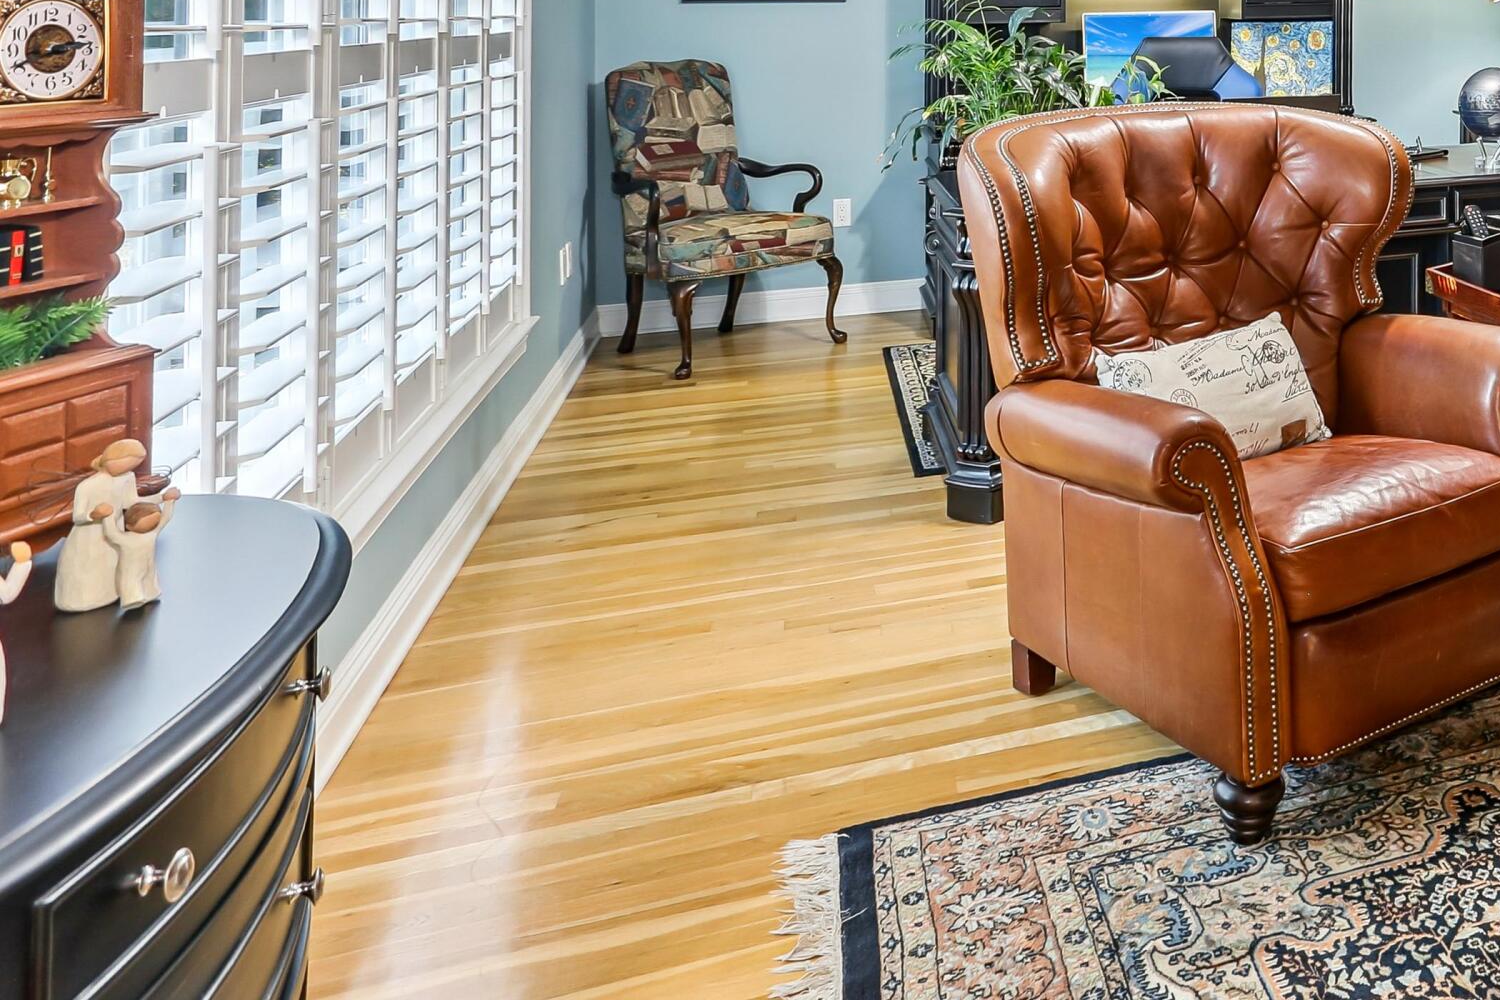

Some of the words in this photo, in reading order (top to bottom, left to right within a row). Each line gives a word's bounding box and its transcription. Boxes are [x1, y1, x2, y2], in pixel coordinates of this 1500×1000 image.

[27, 11, 38, 27] 11
[43, 7, 59, 22] 12
[67, 13, 72, 25] 1
[12, 26, 28, 41] 10
[76, 24, 88, 39] 2
[7, 43, 19, 58] 9
[75, 59, 88, 72] 4
[27, 72, 40, 87] 7
[45, 77, 57, 90] 6
[61, 72, 73, 86] 5
